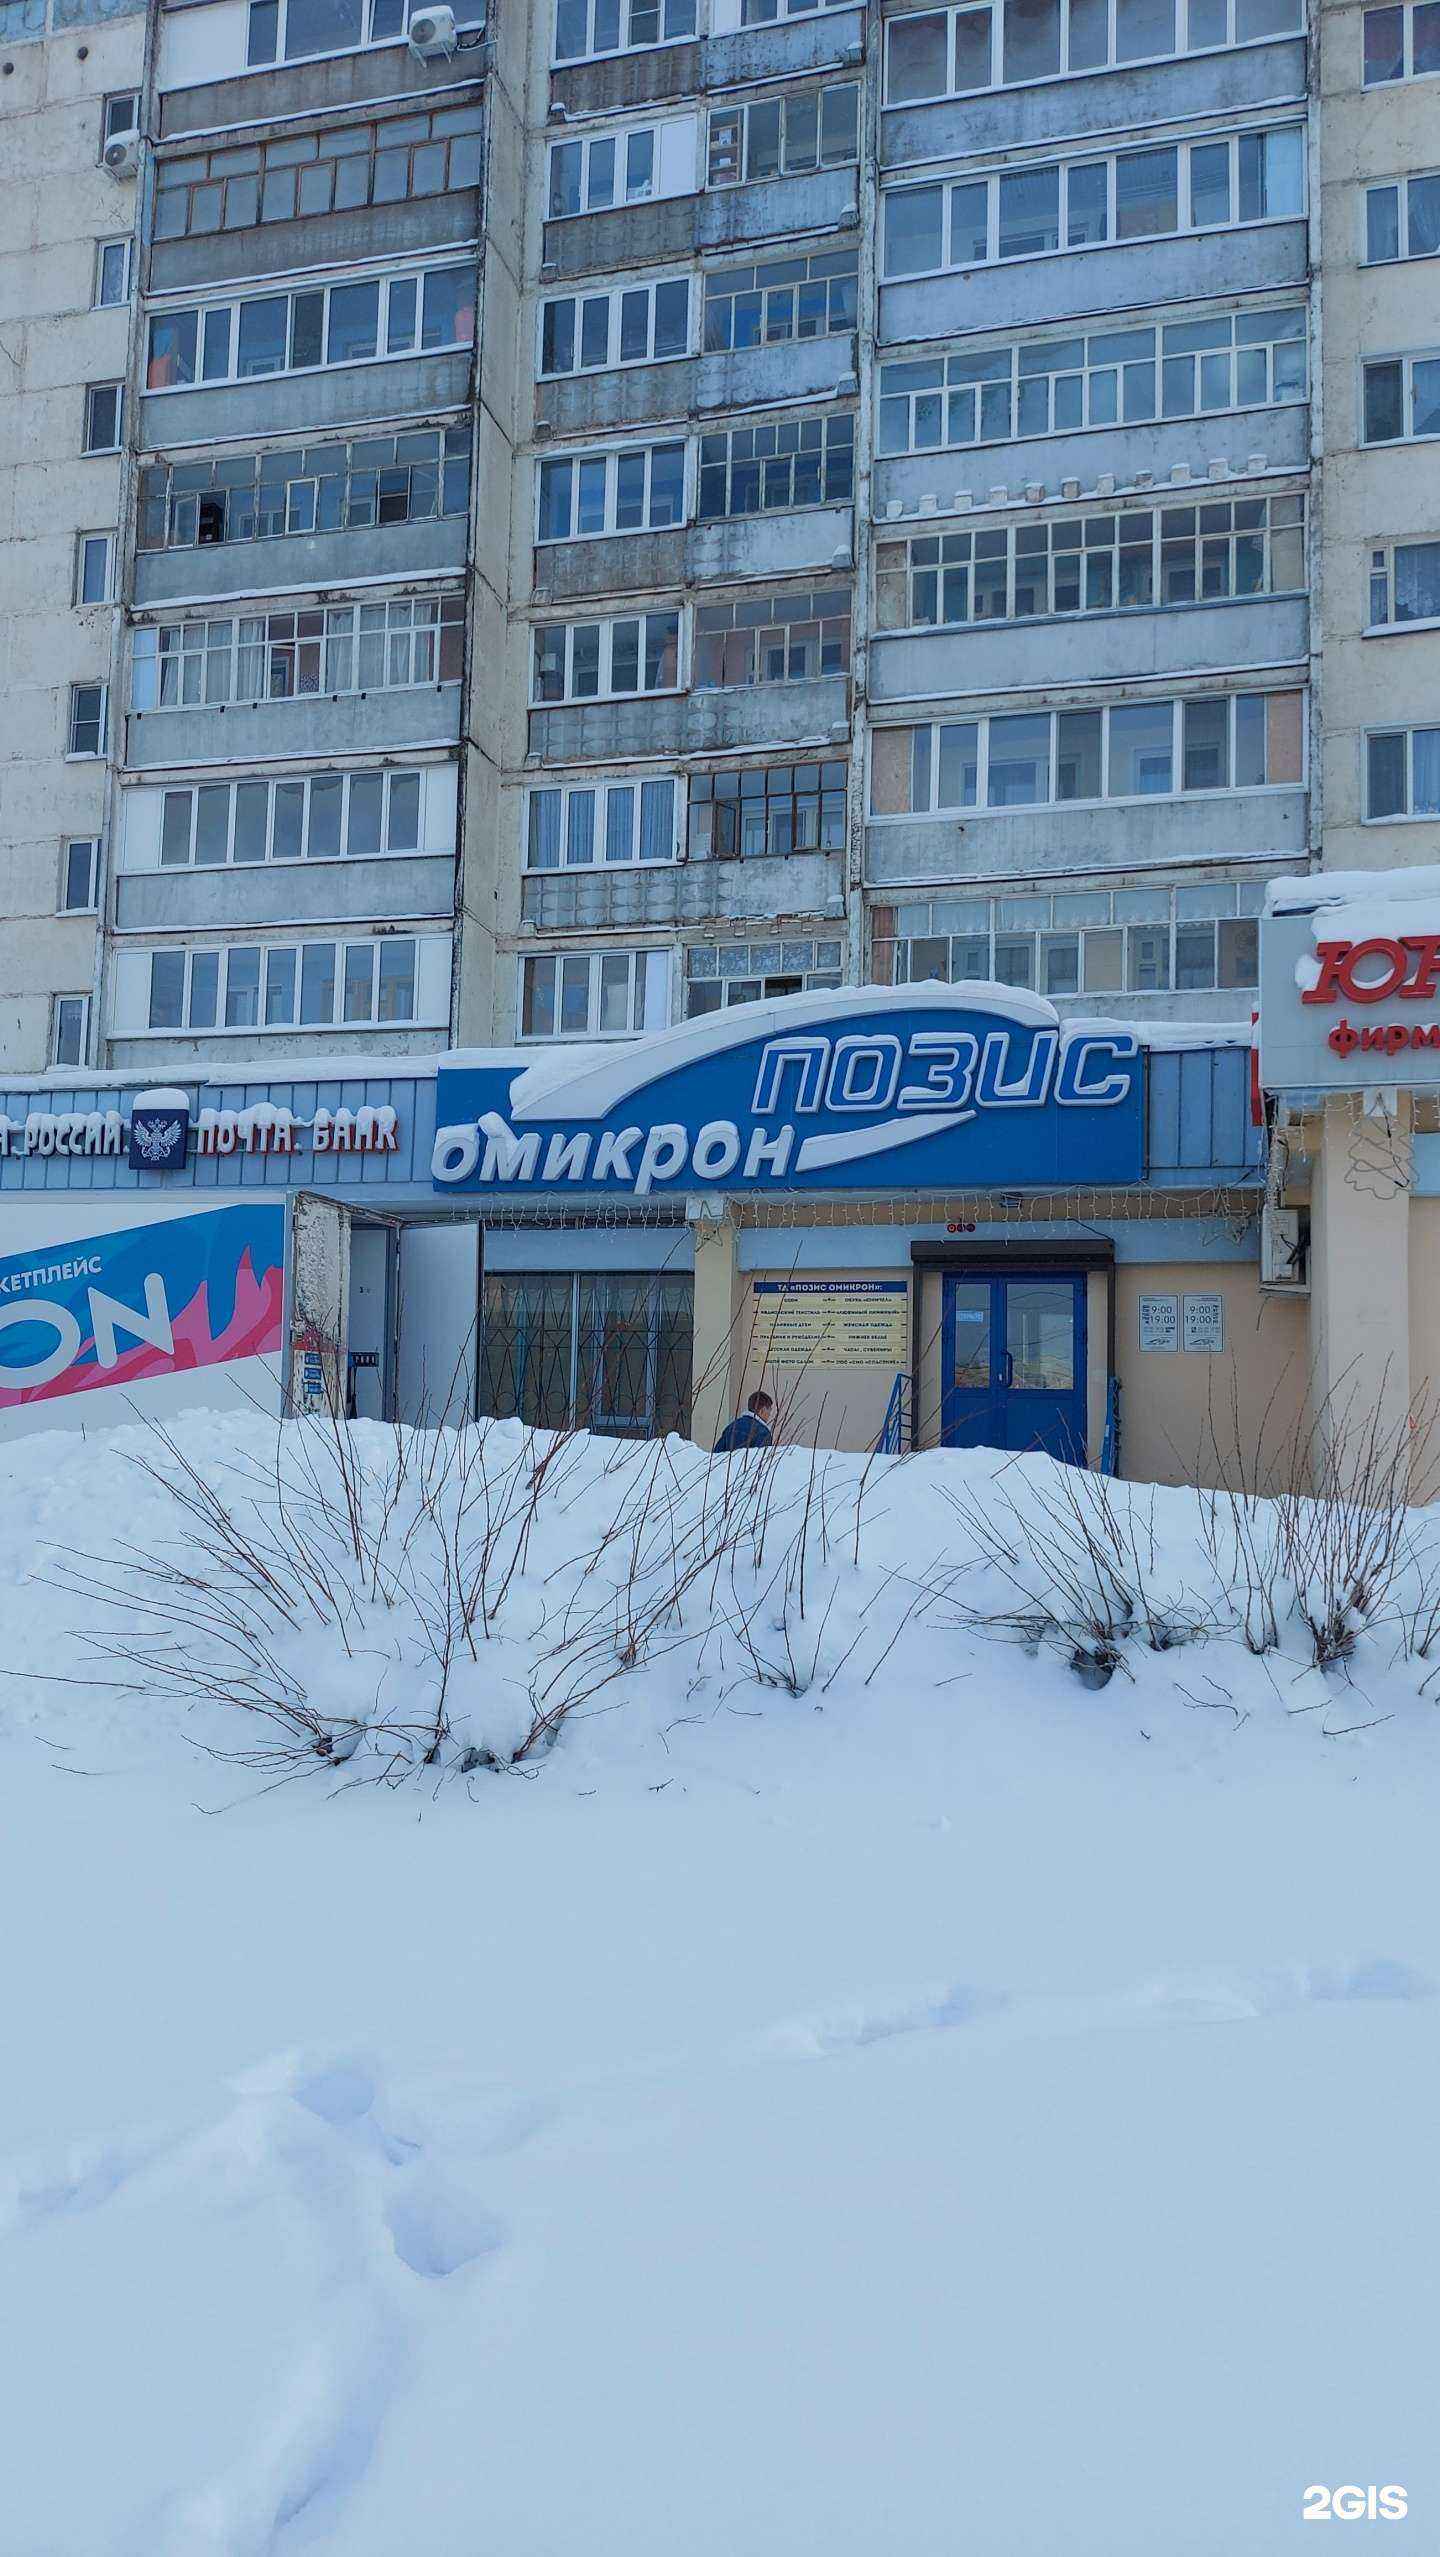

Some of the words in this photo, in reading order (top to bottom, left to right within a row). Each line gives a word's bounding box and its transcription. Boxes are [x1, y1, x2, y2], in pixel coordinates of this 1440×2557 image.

[1328, 1018, 1440, 1059] фирм
[750, 1030, 1140, 1114] ПОЗИС
[313, 1110, 401, 1153] БАНК
[1151, 1305, 1173, 1314] 9:00
[1189, 1305, 1211, 1314] 9:00
[1150, 1315, 1176, 1324] 19:00
[1185, 1315, 1212, 1325] 19:00
